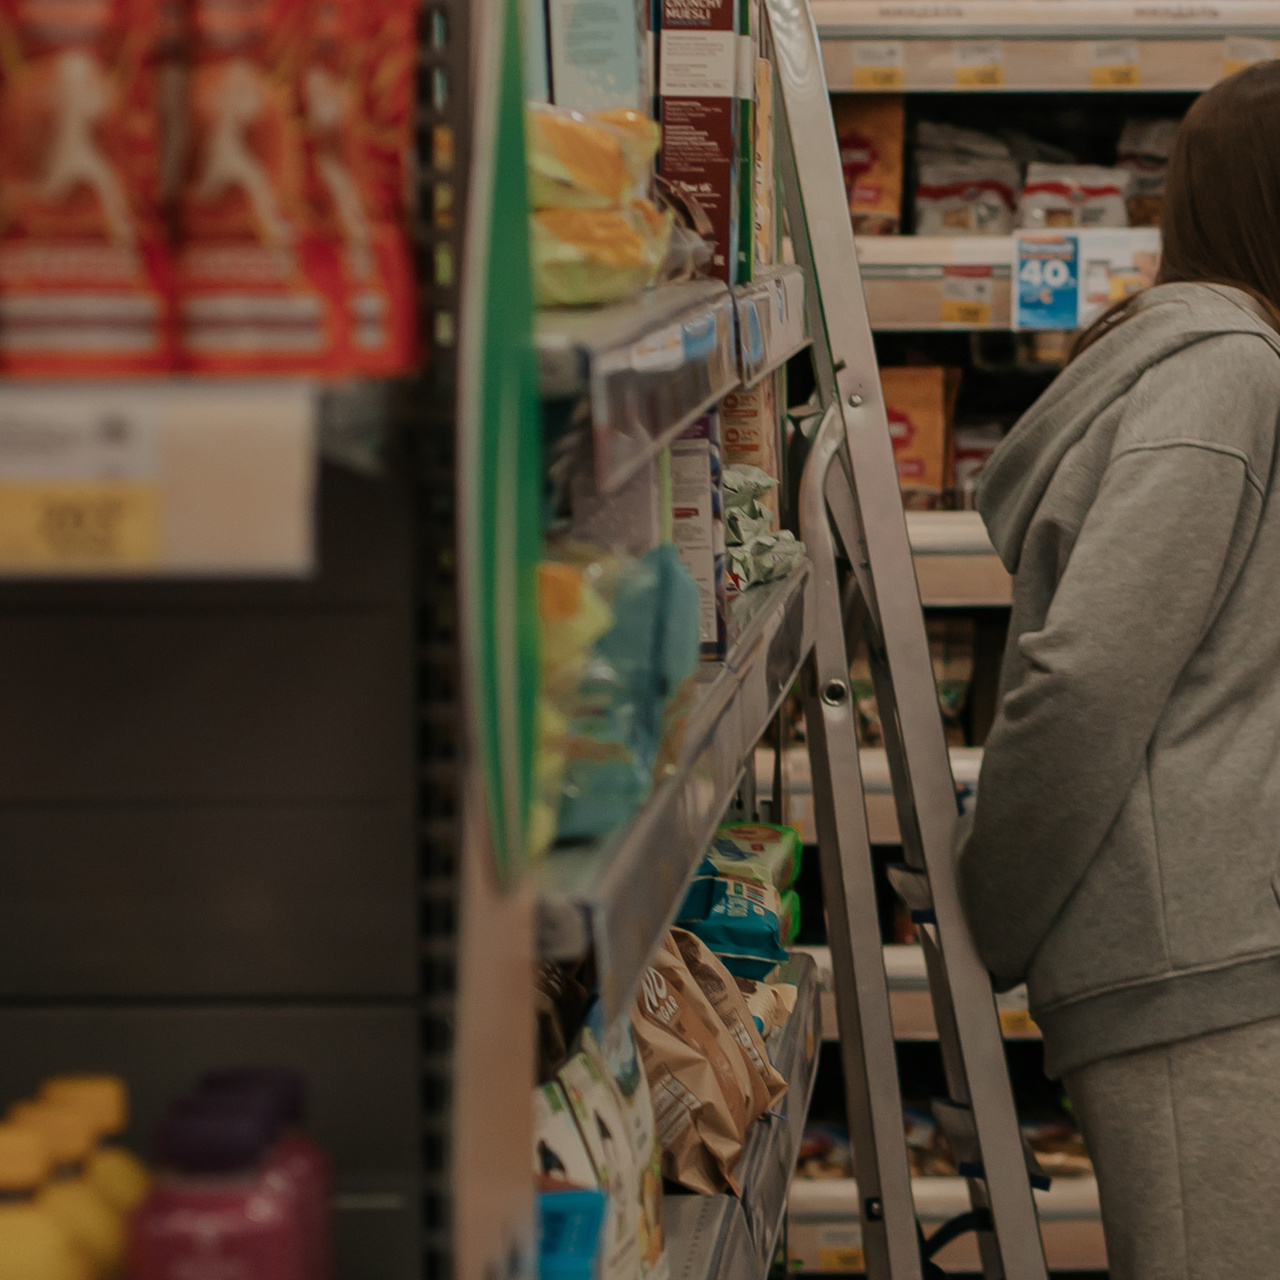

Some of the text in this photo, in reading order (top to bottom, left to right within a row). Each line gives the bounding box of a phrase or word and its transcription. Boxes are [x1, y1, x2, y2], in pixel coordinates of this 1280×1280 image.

[665, 8, 712, 20] MUESLI
[1020, 259, 1070, 287] 40
[641, 967, 668, 1014] NO
